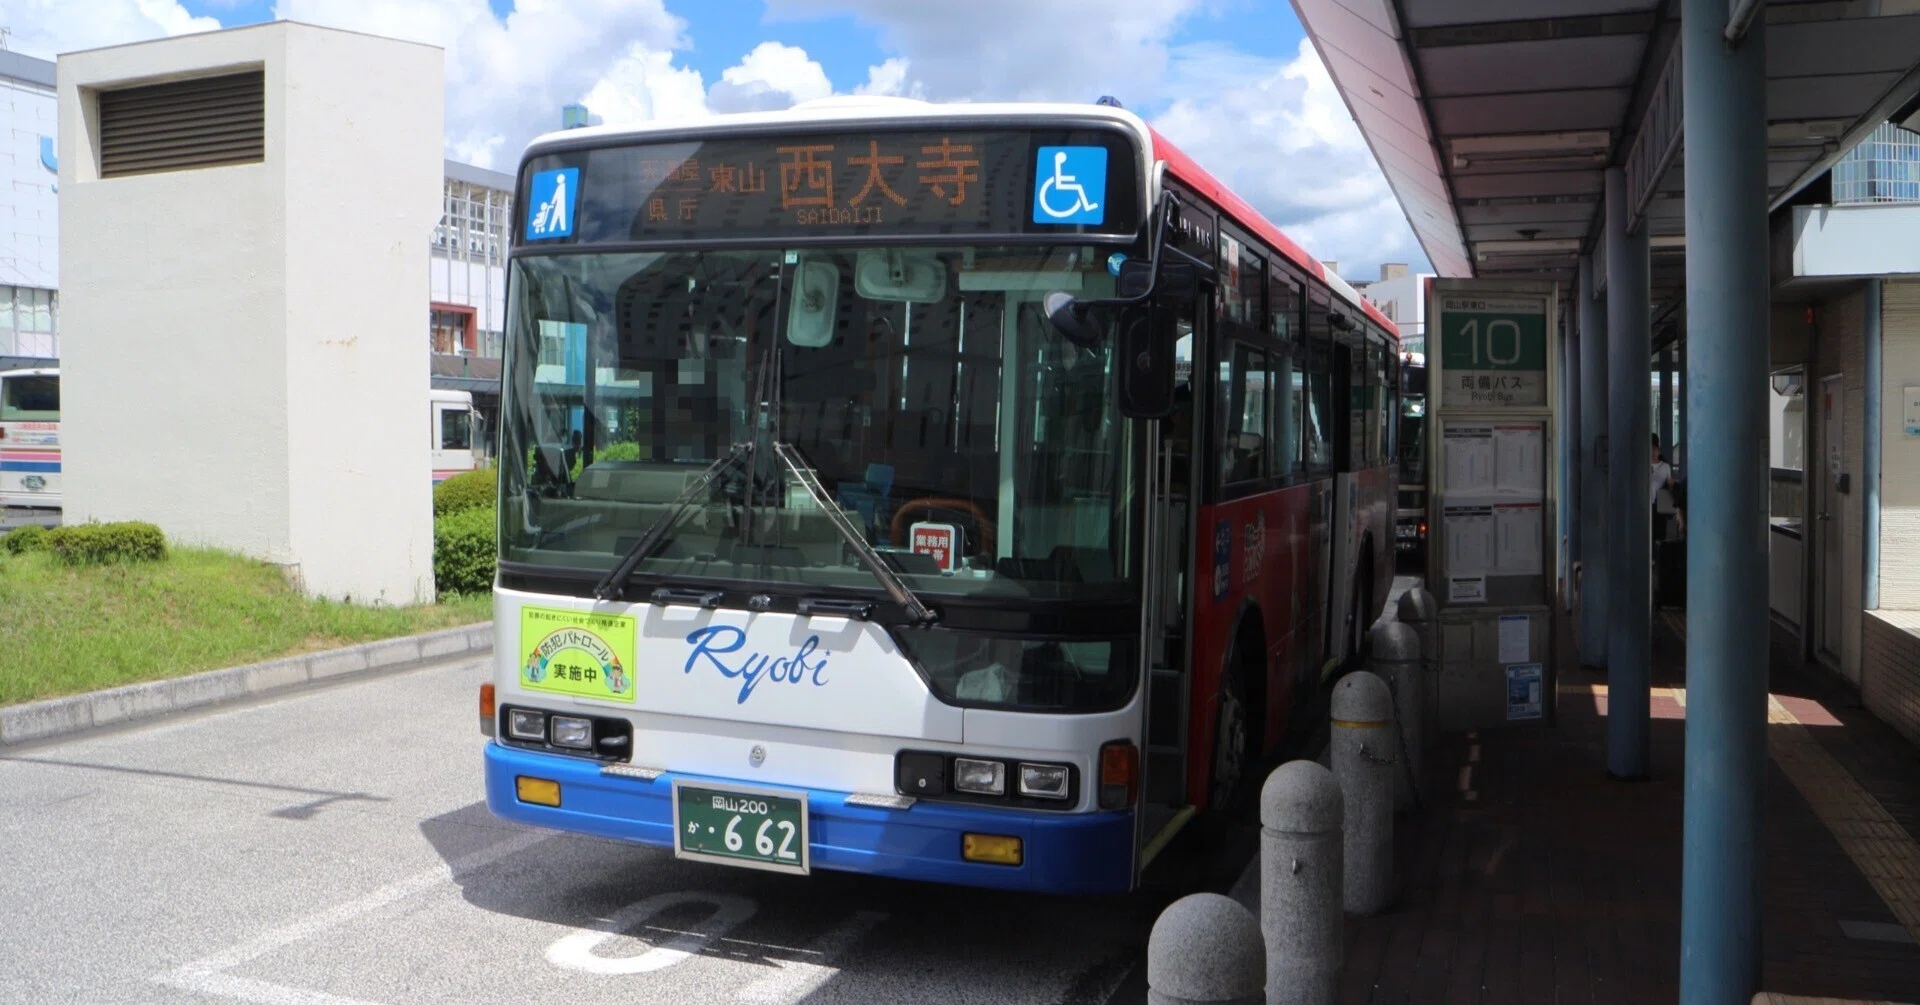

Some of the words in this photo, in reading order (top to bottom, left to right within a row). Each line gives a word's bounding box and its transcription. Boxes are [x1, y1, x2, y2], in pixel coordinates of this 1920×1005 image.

[708, 161, 766, 193] 東山
[776, 138, 979, 209] 西大寺
[648, 197, 698, 221] 県庁
[796, 207, 883, 225] SAIDAIJI
[1459, 318, 1521, 365] 10
[1461, 375, 1522, 390] 両備バス
[916, 534, 949, 548] 業務用
[540, 631, 609, 662] 防犯パトロール
[553, 663, 598, 683] 実施中
[684, 624, 831, 705] Ryobi
